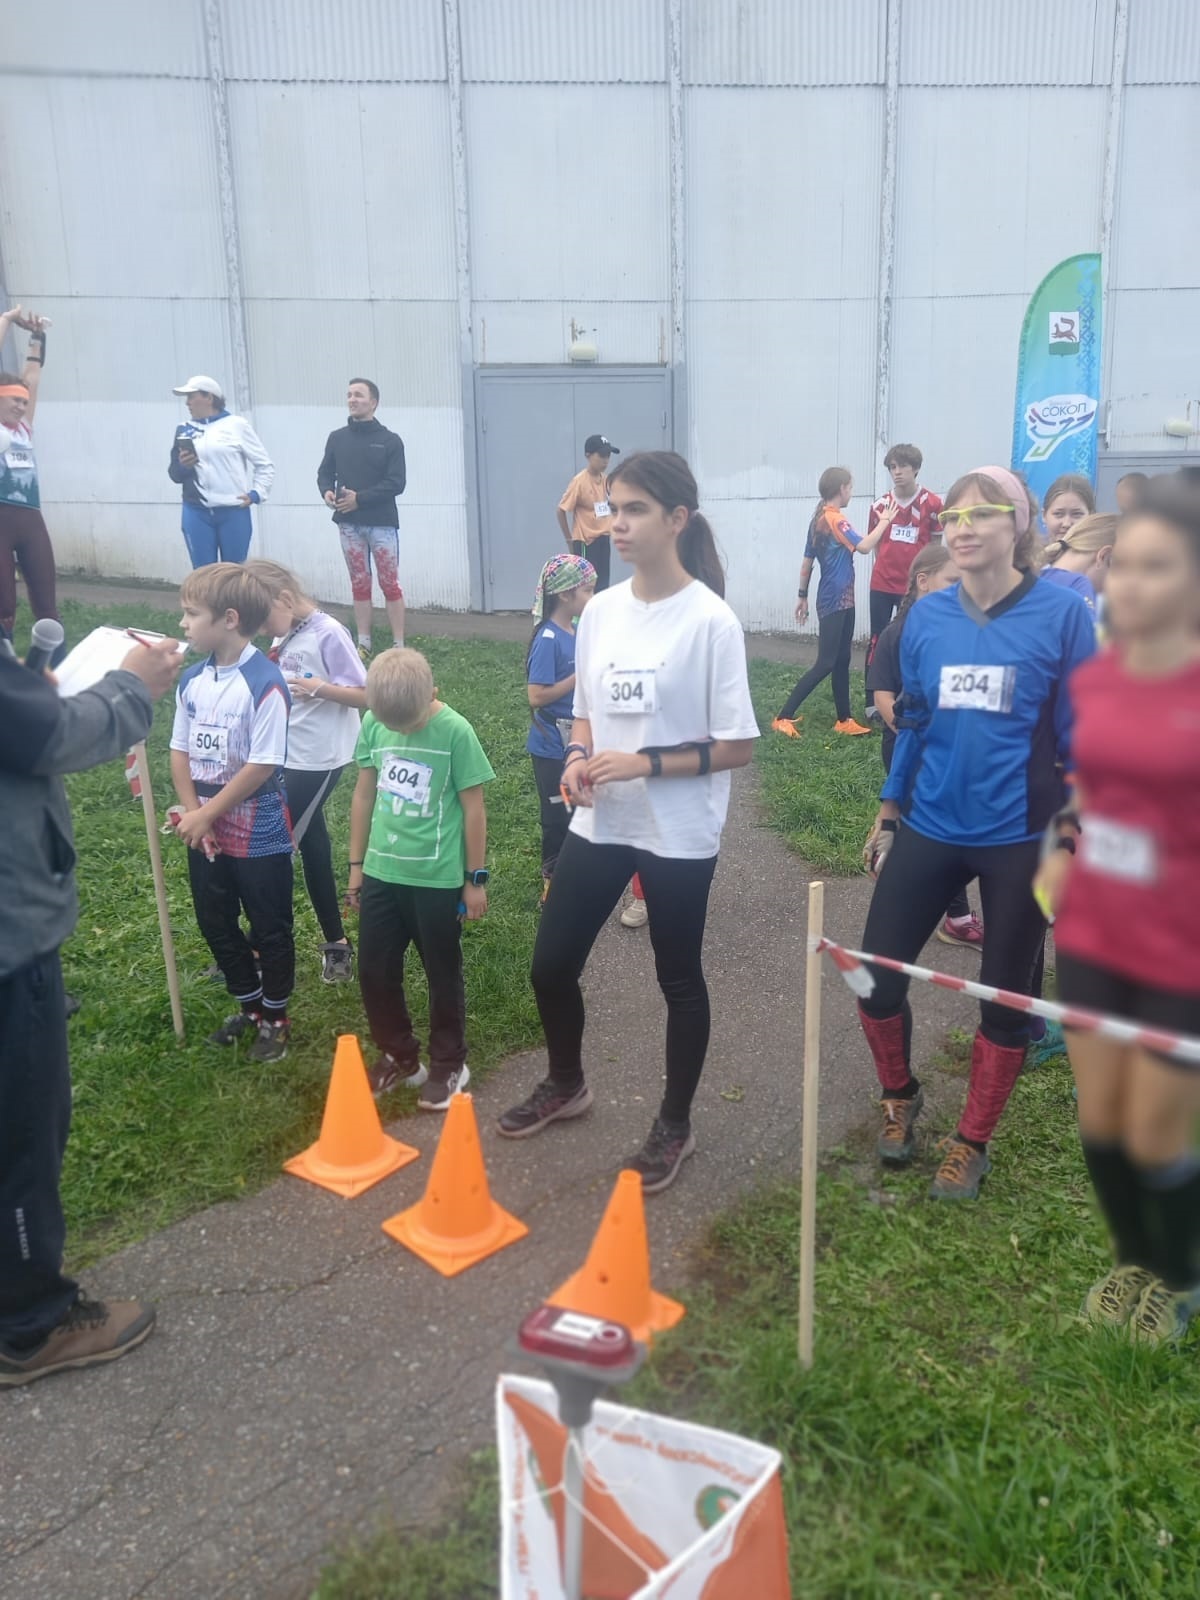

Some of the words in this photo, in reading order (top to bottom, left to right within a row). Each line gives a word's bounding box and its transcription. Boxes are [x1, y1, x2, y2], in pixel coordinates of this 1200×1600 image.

[610, 681, 644, 701] 304
[951, 673, 989, 694] 204
[196, 733, 220, 750] 504
[388, 765, 420, 788] 604
